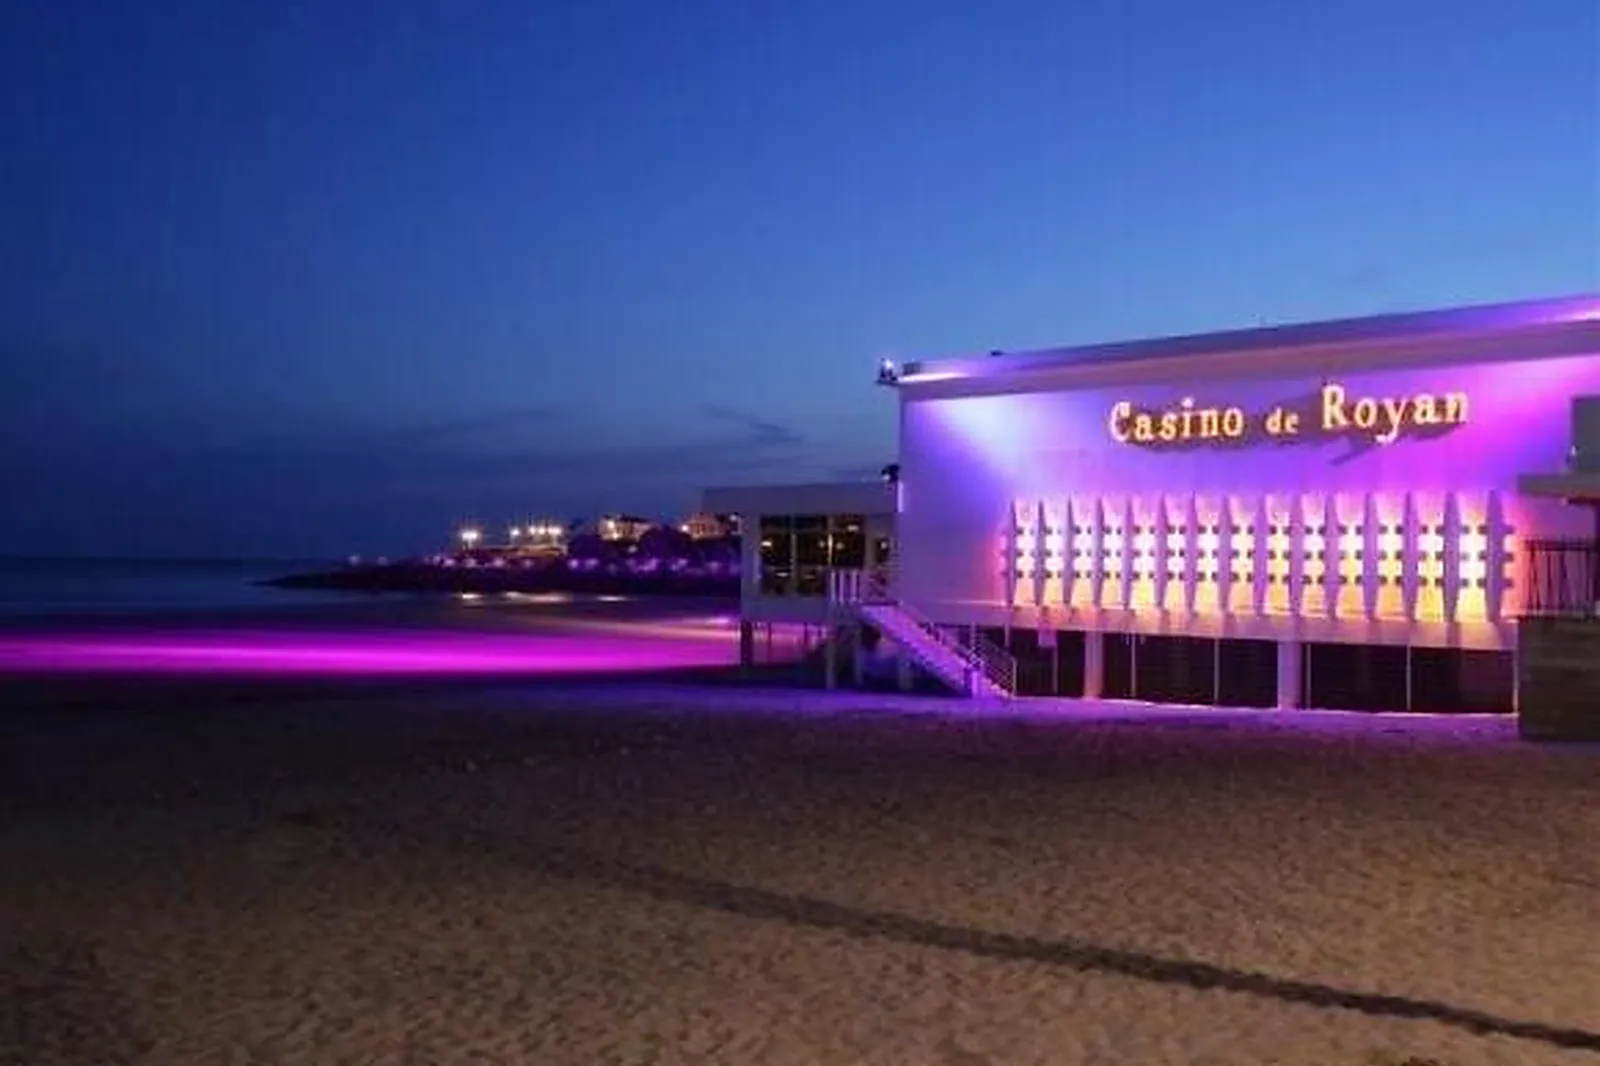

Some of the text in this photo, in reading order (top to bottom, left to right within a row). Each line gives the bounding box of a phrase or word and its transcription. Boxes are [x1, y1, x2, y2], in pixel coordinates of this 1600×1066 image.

[1109, 384, 1469, 443] Casino de Royan
